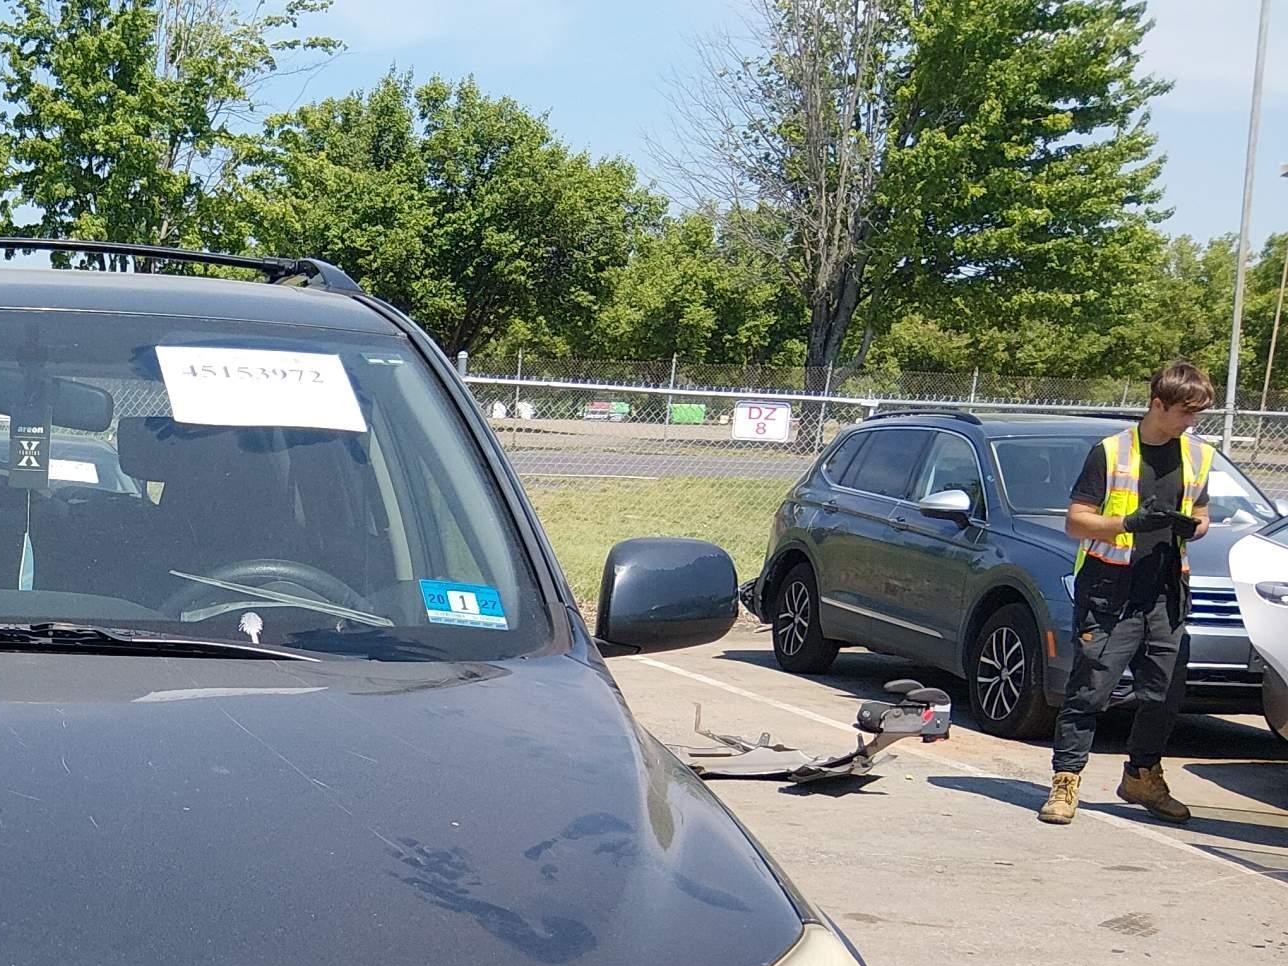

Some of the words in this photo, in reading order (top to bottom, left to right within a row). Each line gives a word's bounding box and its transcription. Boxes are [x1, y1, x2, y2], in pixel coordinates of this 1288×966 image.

[182, 364, 325, 384] 45153972
[748, 406, 777, 421] DZ
[755, 422, 767, 435] 8
[428, 593, 445, 605] 20
[458, 595, 469, 611] 1
[480, 599, 497, 610] 27
